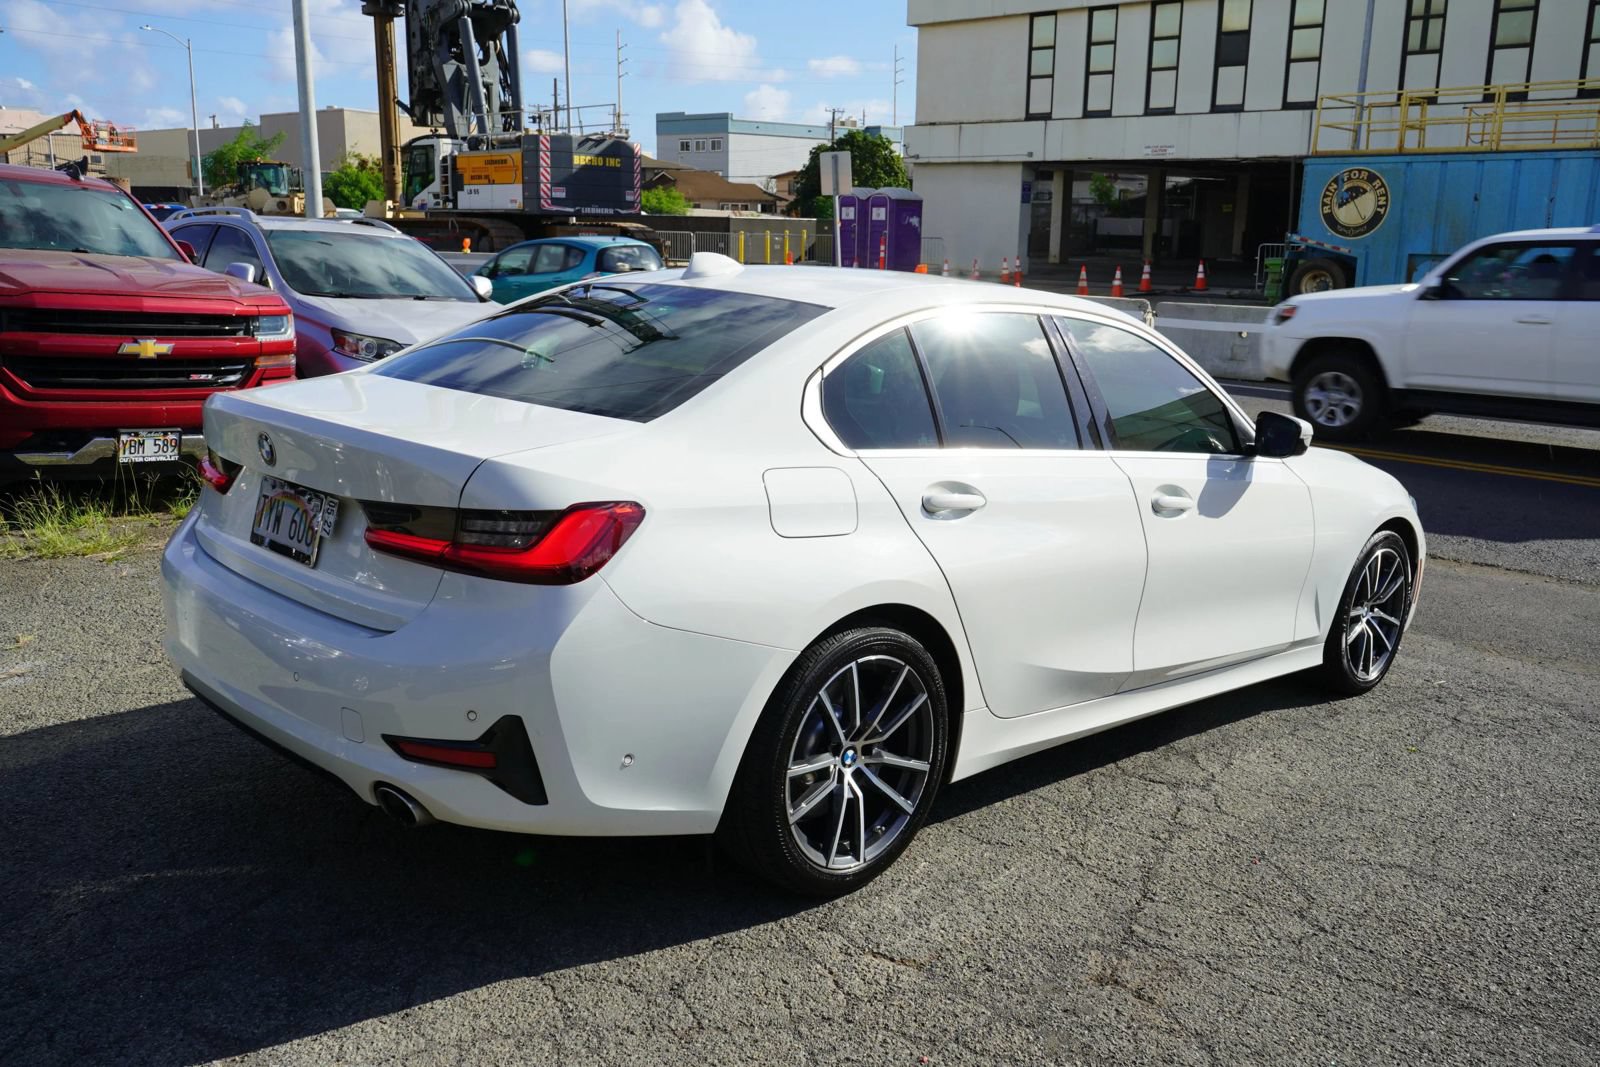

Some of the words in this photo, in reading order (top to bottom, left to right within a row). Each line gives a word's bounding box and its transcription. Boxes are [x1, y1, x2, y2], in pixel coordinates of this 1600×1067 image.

[573, 155, 603, 166] BECHO
[606, 157, 621, 167] INC
[1323, 182, 1338, 214] RAIN
[1344, 170, 1369, 181] FOR
[1372, 179, 1387, 214] RENT
[121, 439, 145, 455] YBM
[153, 438, 178, 454] 589
[288, 507, 317, 547] 606
